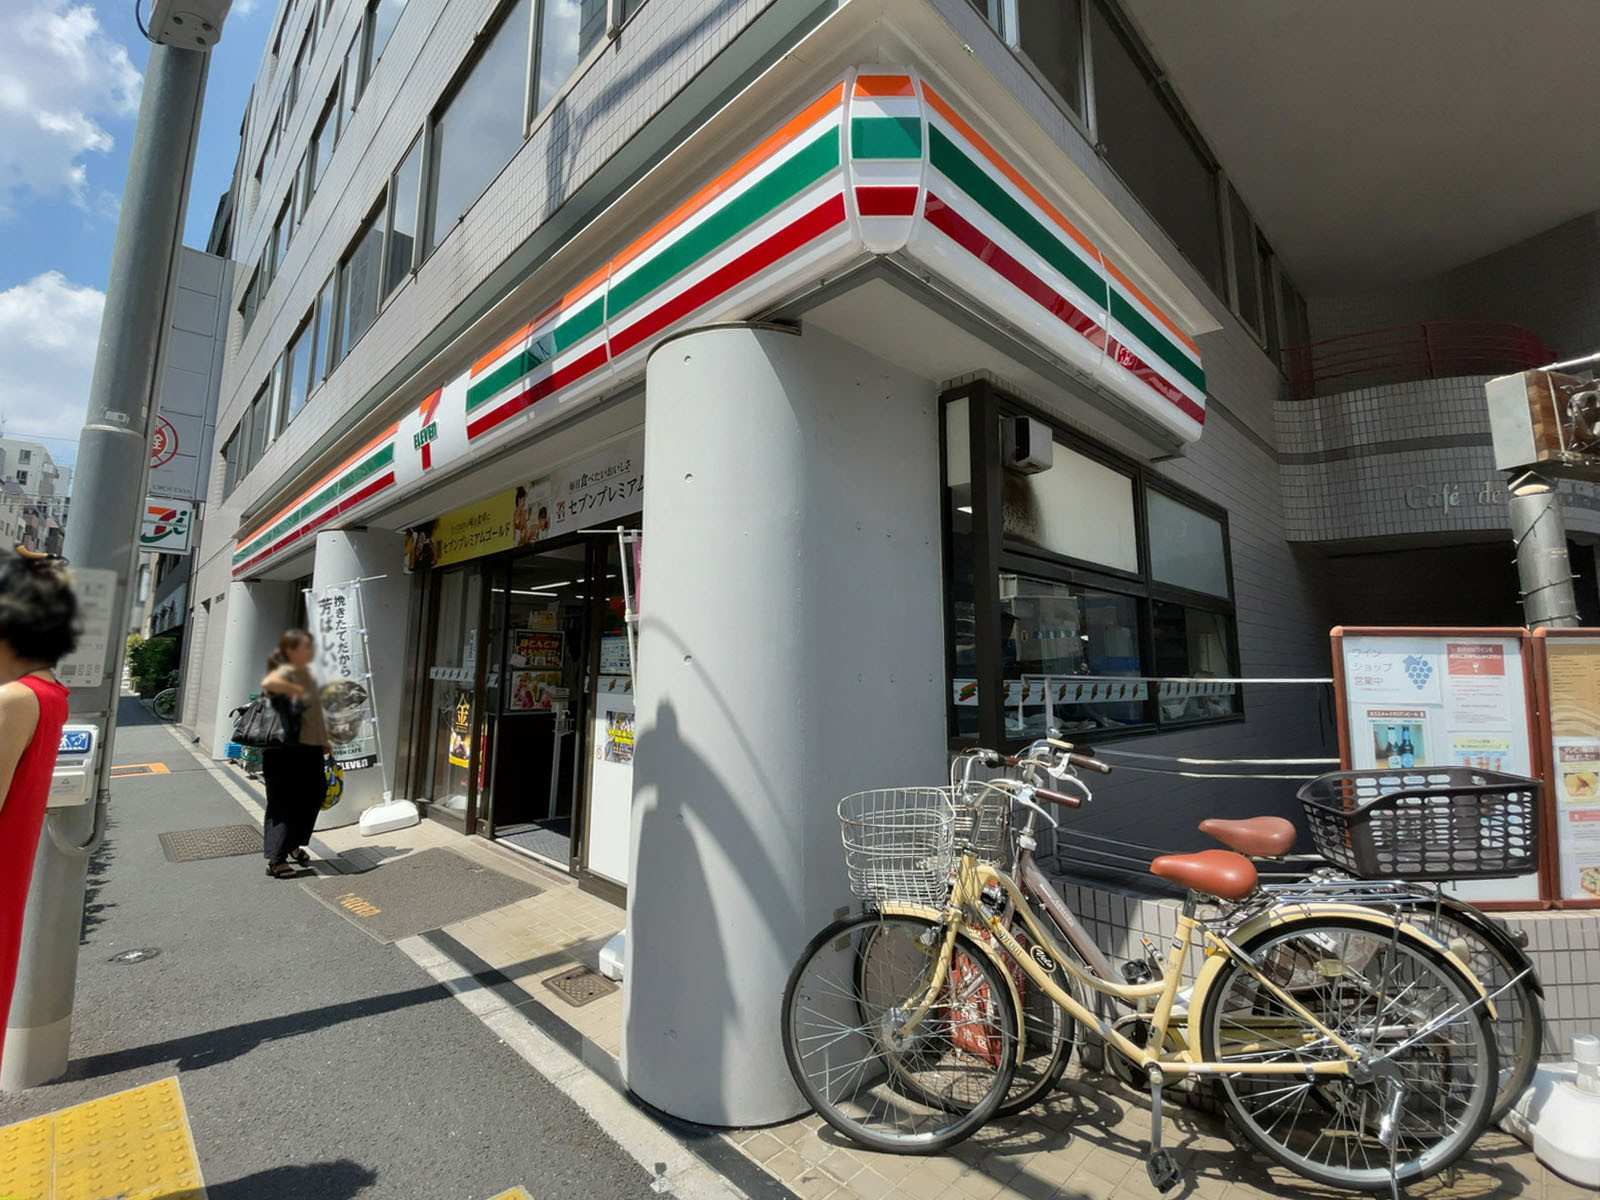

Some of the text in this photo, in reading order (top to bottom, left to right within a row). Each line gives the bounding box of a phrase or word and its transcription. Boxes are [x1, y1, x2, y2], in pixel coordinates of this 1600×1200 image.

[334, 595, 351, 677] 挽きたてだから
[1352, 648, 1382, 658] ワイン
[1352, 662, 1393, 672] ショップ
